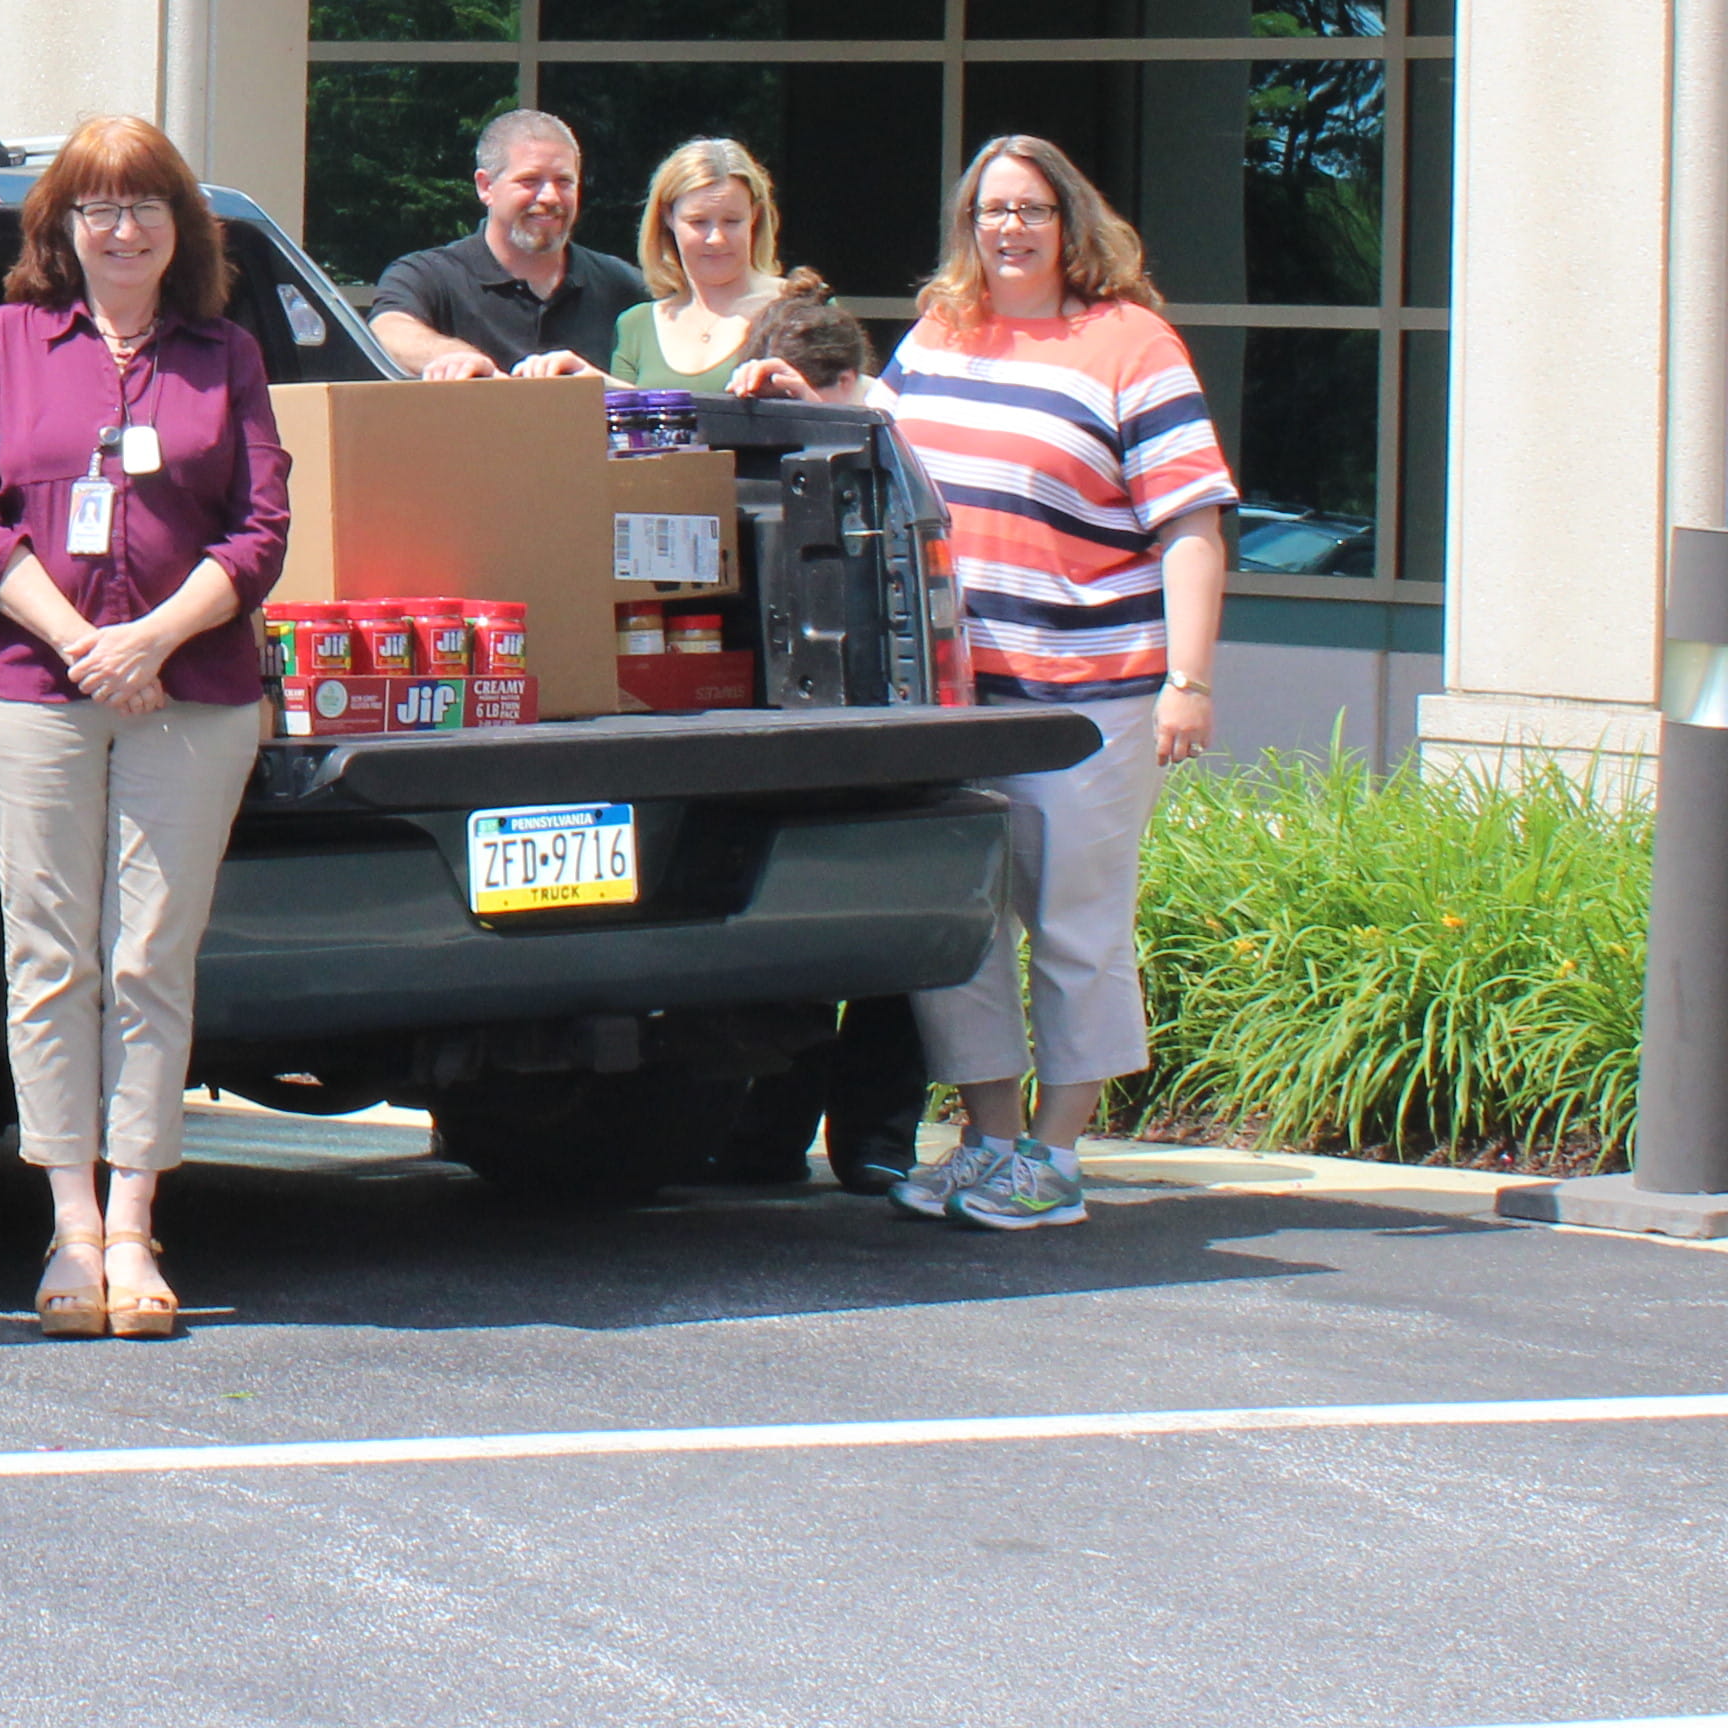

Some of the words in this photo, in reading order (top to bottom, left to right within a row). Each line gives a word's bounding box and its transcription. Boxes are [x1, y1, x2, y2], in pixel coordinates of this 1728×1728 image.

[474, 679, 526, 695] CREAMY
[397, 683, 457, 724] Jif
[476, 703, 484, 718] 6
[486, 702, 500, 718] LB
[511, 812, 595, 830] PENNSYLVANIA
[531, 886, 581, 902] TRUCK
